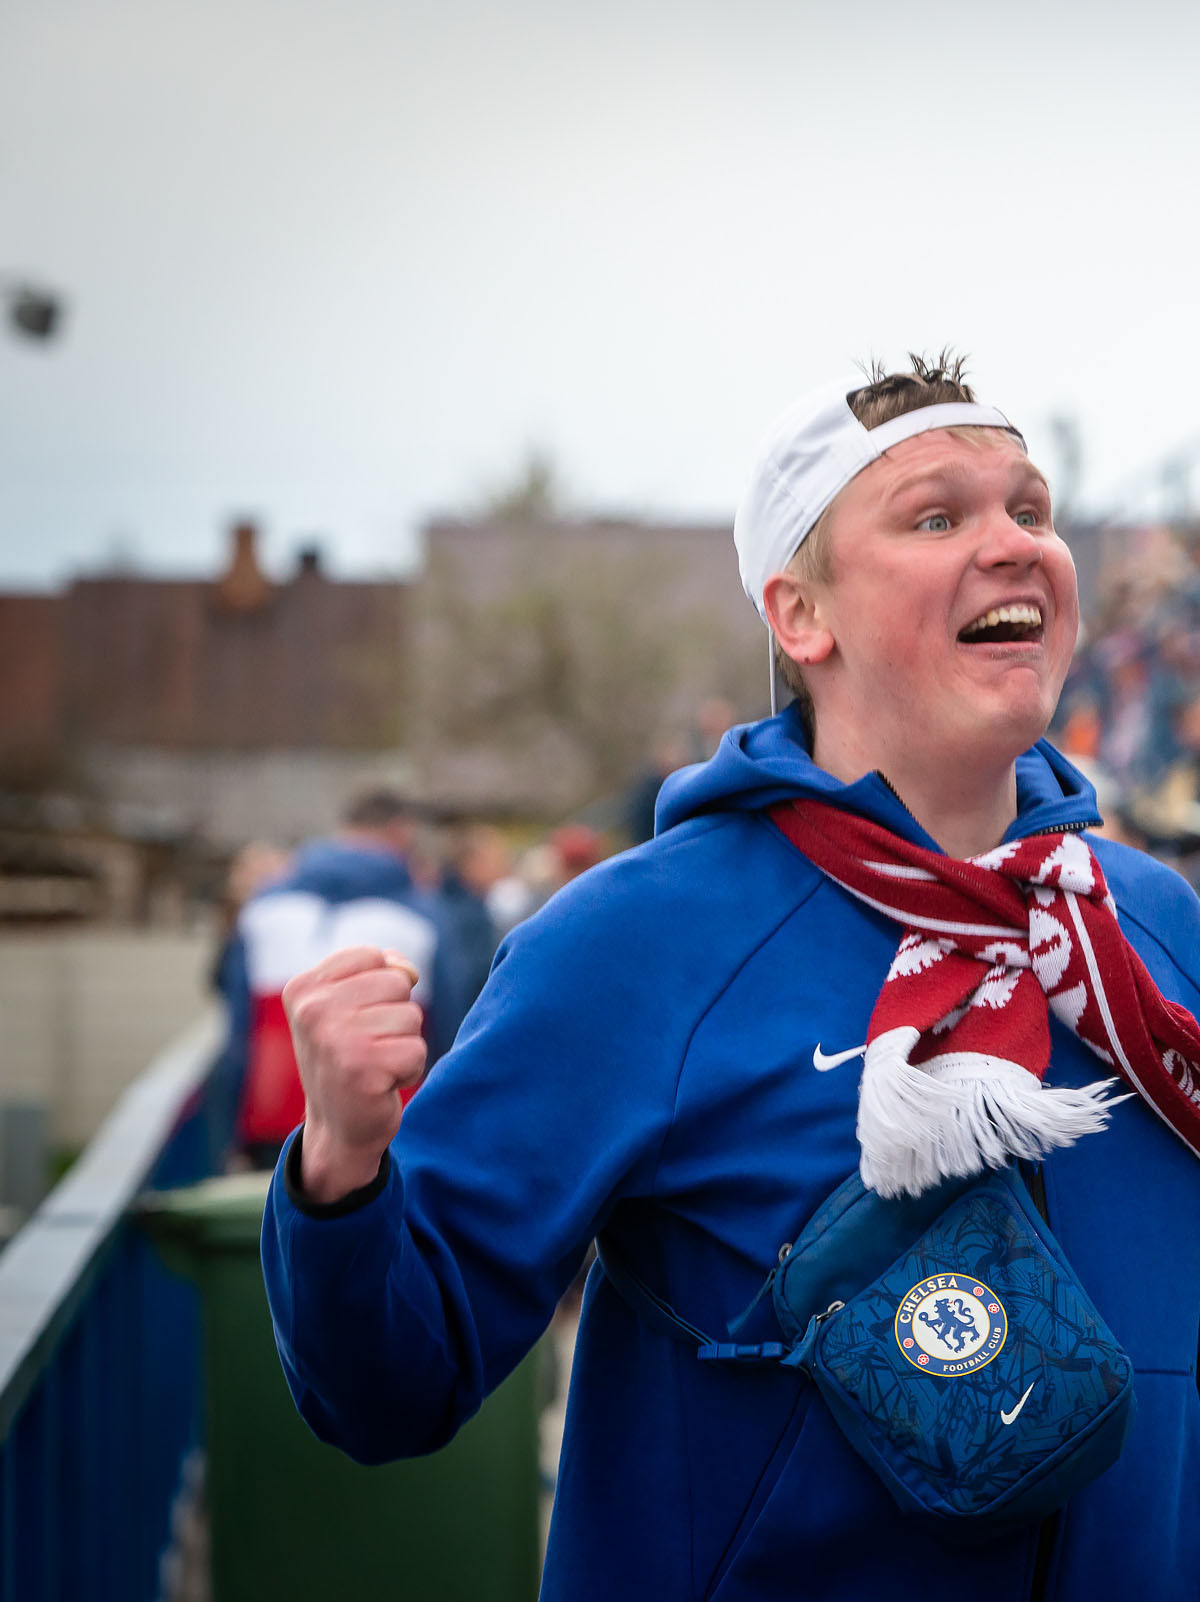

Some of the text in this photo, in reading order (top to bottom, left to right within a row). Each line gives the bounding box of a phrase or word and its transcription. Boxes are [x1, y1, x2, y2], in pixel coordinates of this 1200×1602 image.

[900, 1276, 958, 1323] CHELSEA
[943, 1327, 1002, 1372] FOOTBALL CLUB
